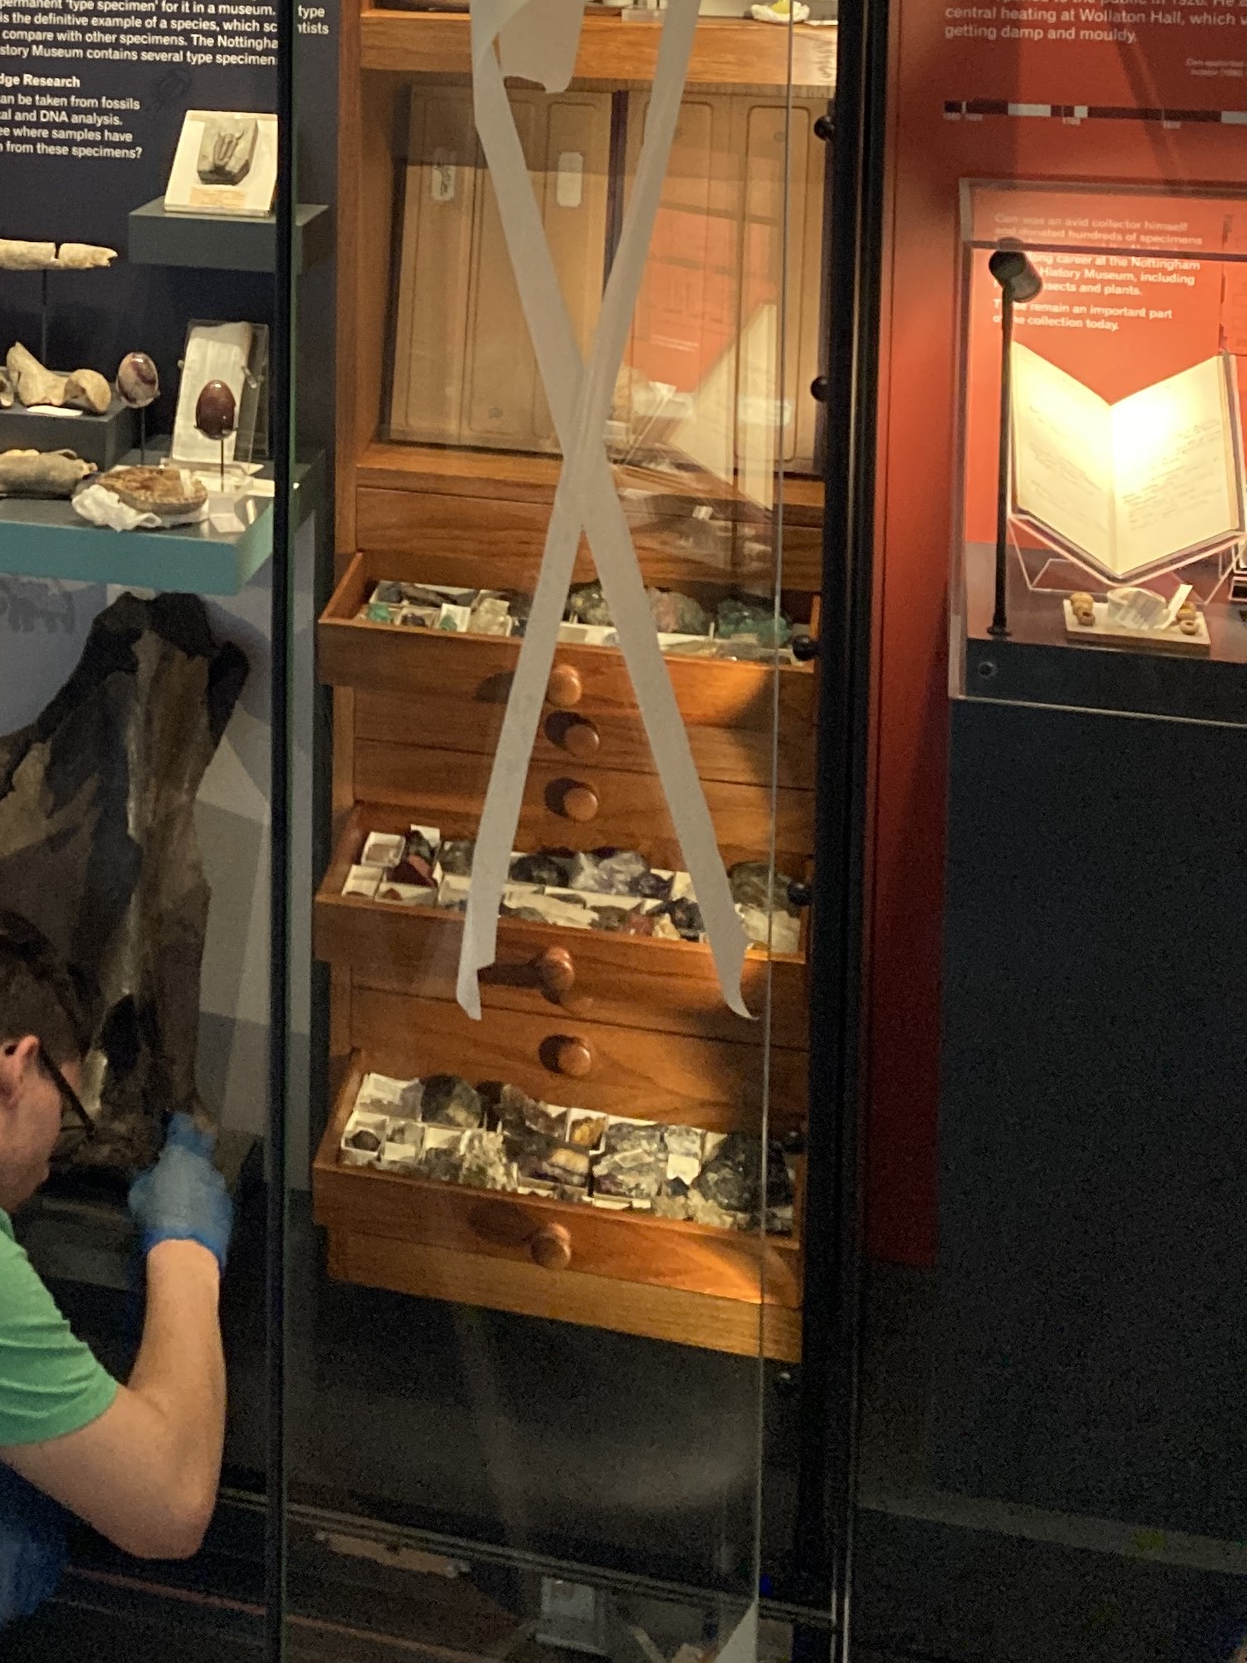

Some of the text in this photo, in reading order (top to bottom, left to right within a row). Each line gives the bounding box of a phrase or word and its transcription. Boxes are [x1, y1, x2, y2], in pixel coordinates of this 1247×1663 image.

[22, 72, 80, 87] Research
[17, 91, 33, 105] be
[34, 92, 68, 107] taken
[69, 94, 99, 108] from
[100, 95, 140, 110] fossils
[13, 107, 37, 121] and
[39, 109, 69, 123] DNA
[70, 110, 123, 128] analysis.
[12, 123, 49, 138] where
[51, 125, 102, 144] samples
[103, 128, 133, 142] have
[4, 139, 34, 153] from
[35, 140, 69, 155] these
[71, 142, 143, 162] specimens?
